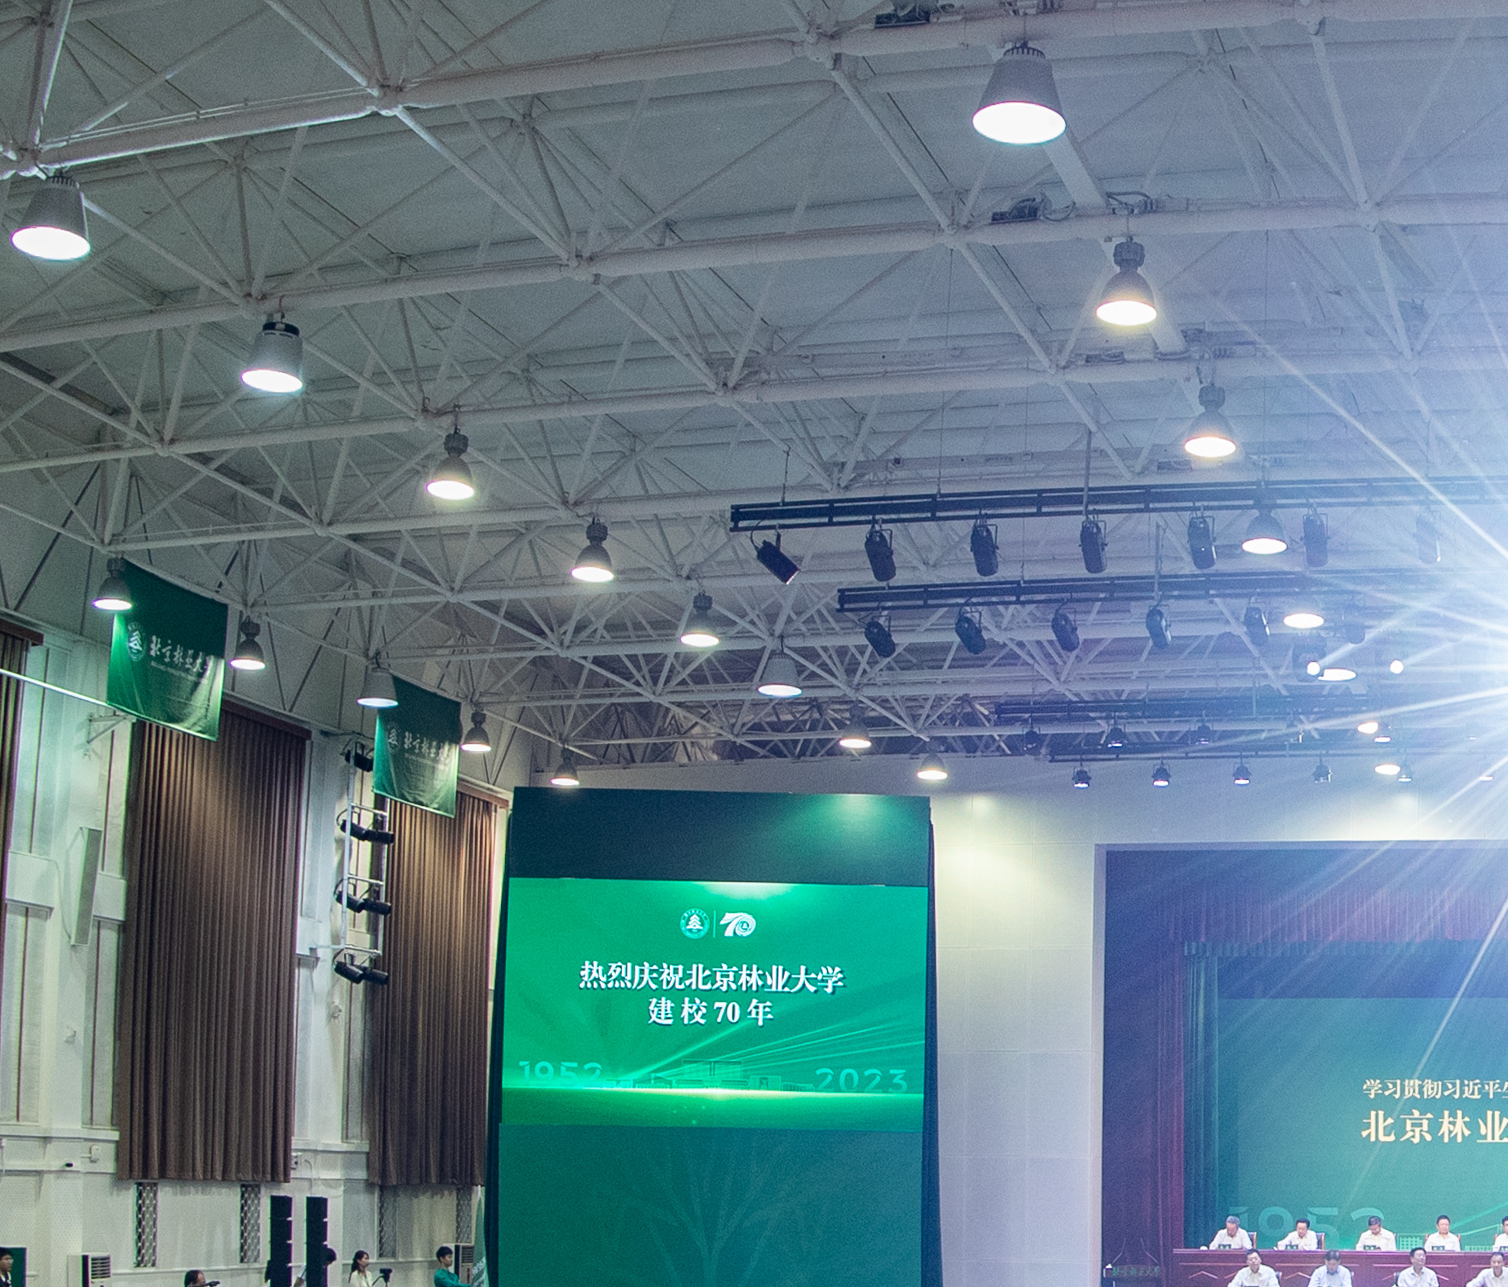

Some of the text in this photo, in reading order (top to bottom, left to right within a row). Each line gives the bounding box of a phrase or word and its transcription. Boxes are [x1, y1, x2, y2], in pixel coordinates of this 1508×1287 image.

[579, 961, 844, 994] 热烈庆祝北京林业大学
